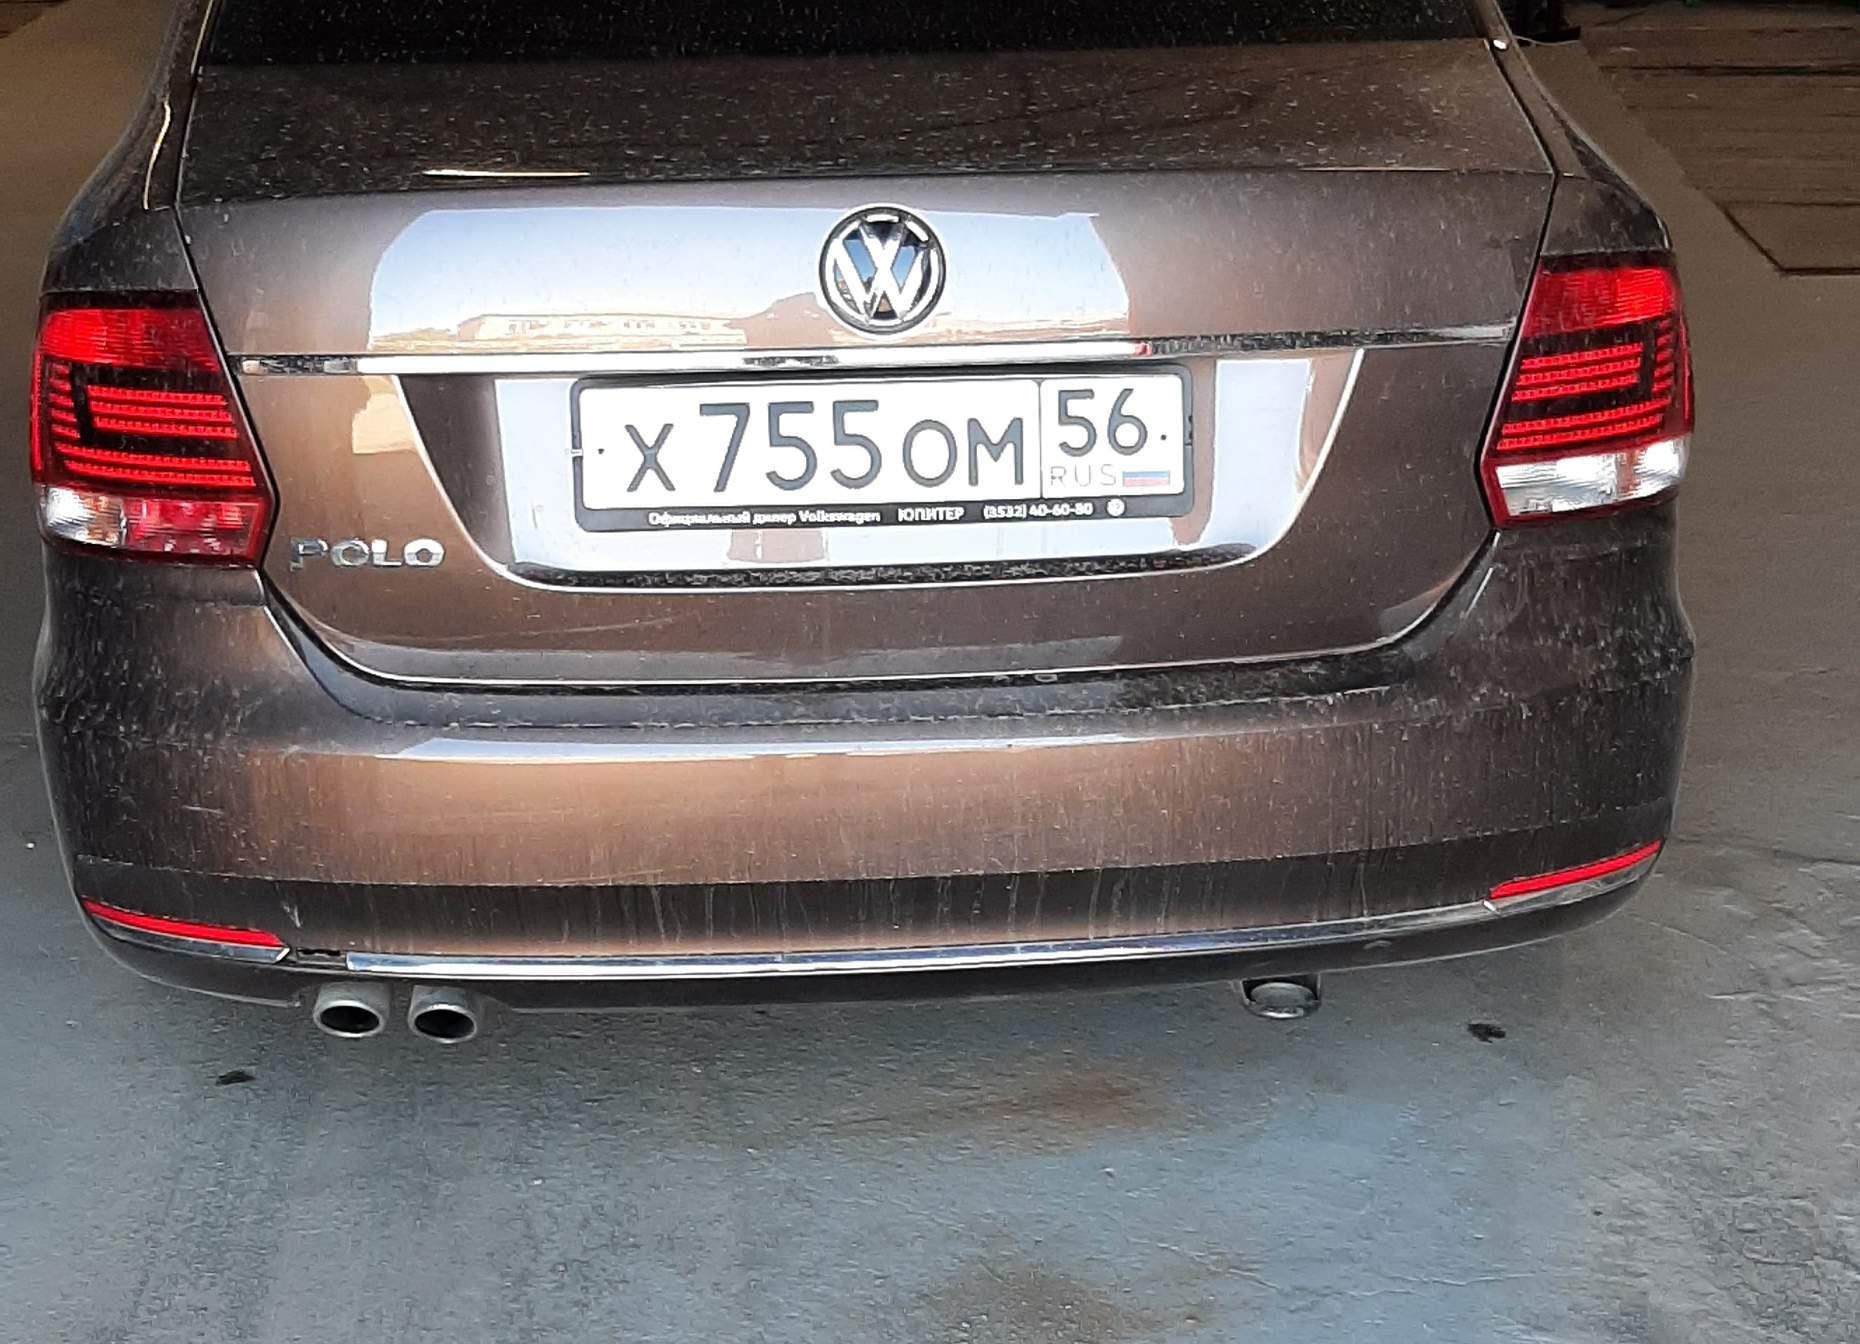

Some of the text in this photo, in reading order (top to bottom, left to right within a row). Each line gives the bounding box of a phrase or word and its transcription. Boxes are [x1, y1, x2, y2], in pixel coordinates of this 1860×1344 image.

[1057, 387, 1149, 457] 56
[1049, 463, 1118, 487] RUS
[288, 536, 446, 573] POLO
